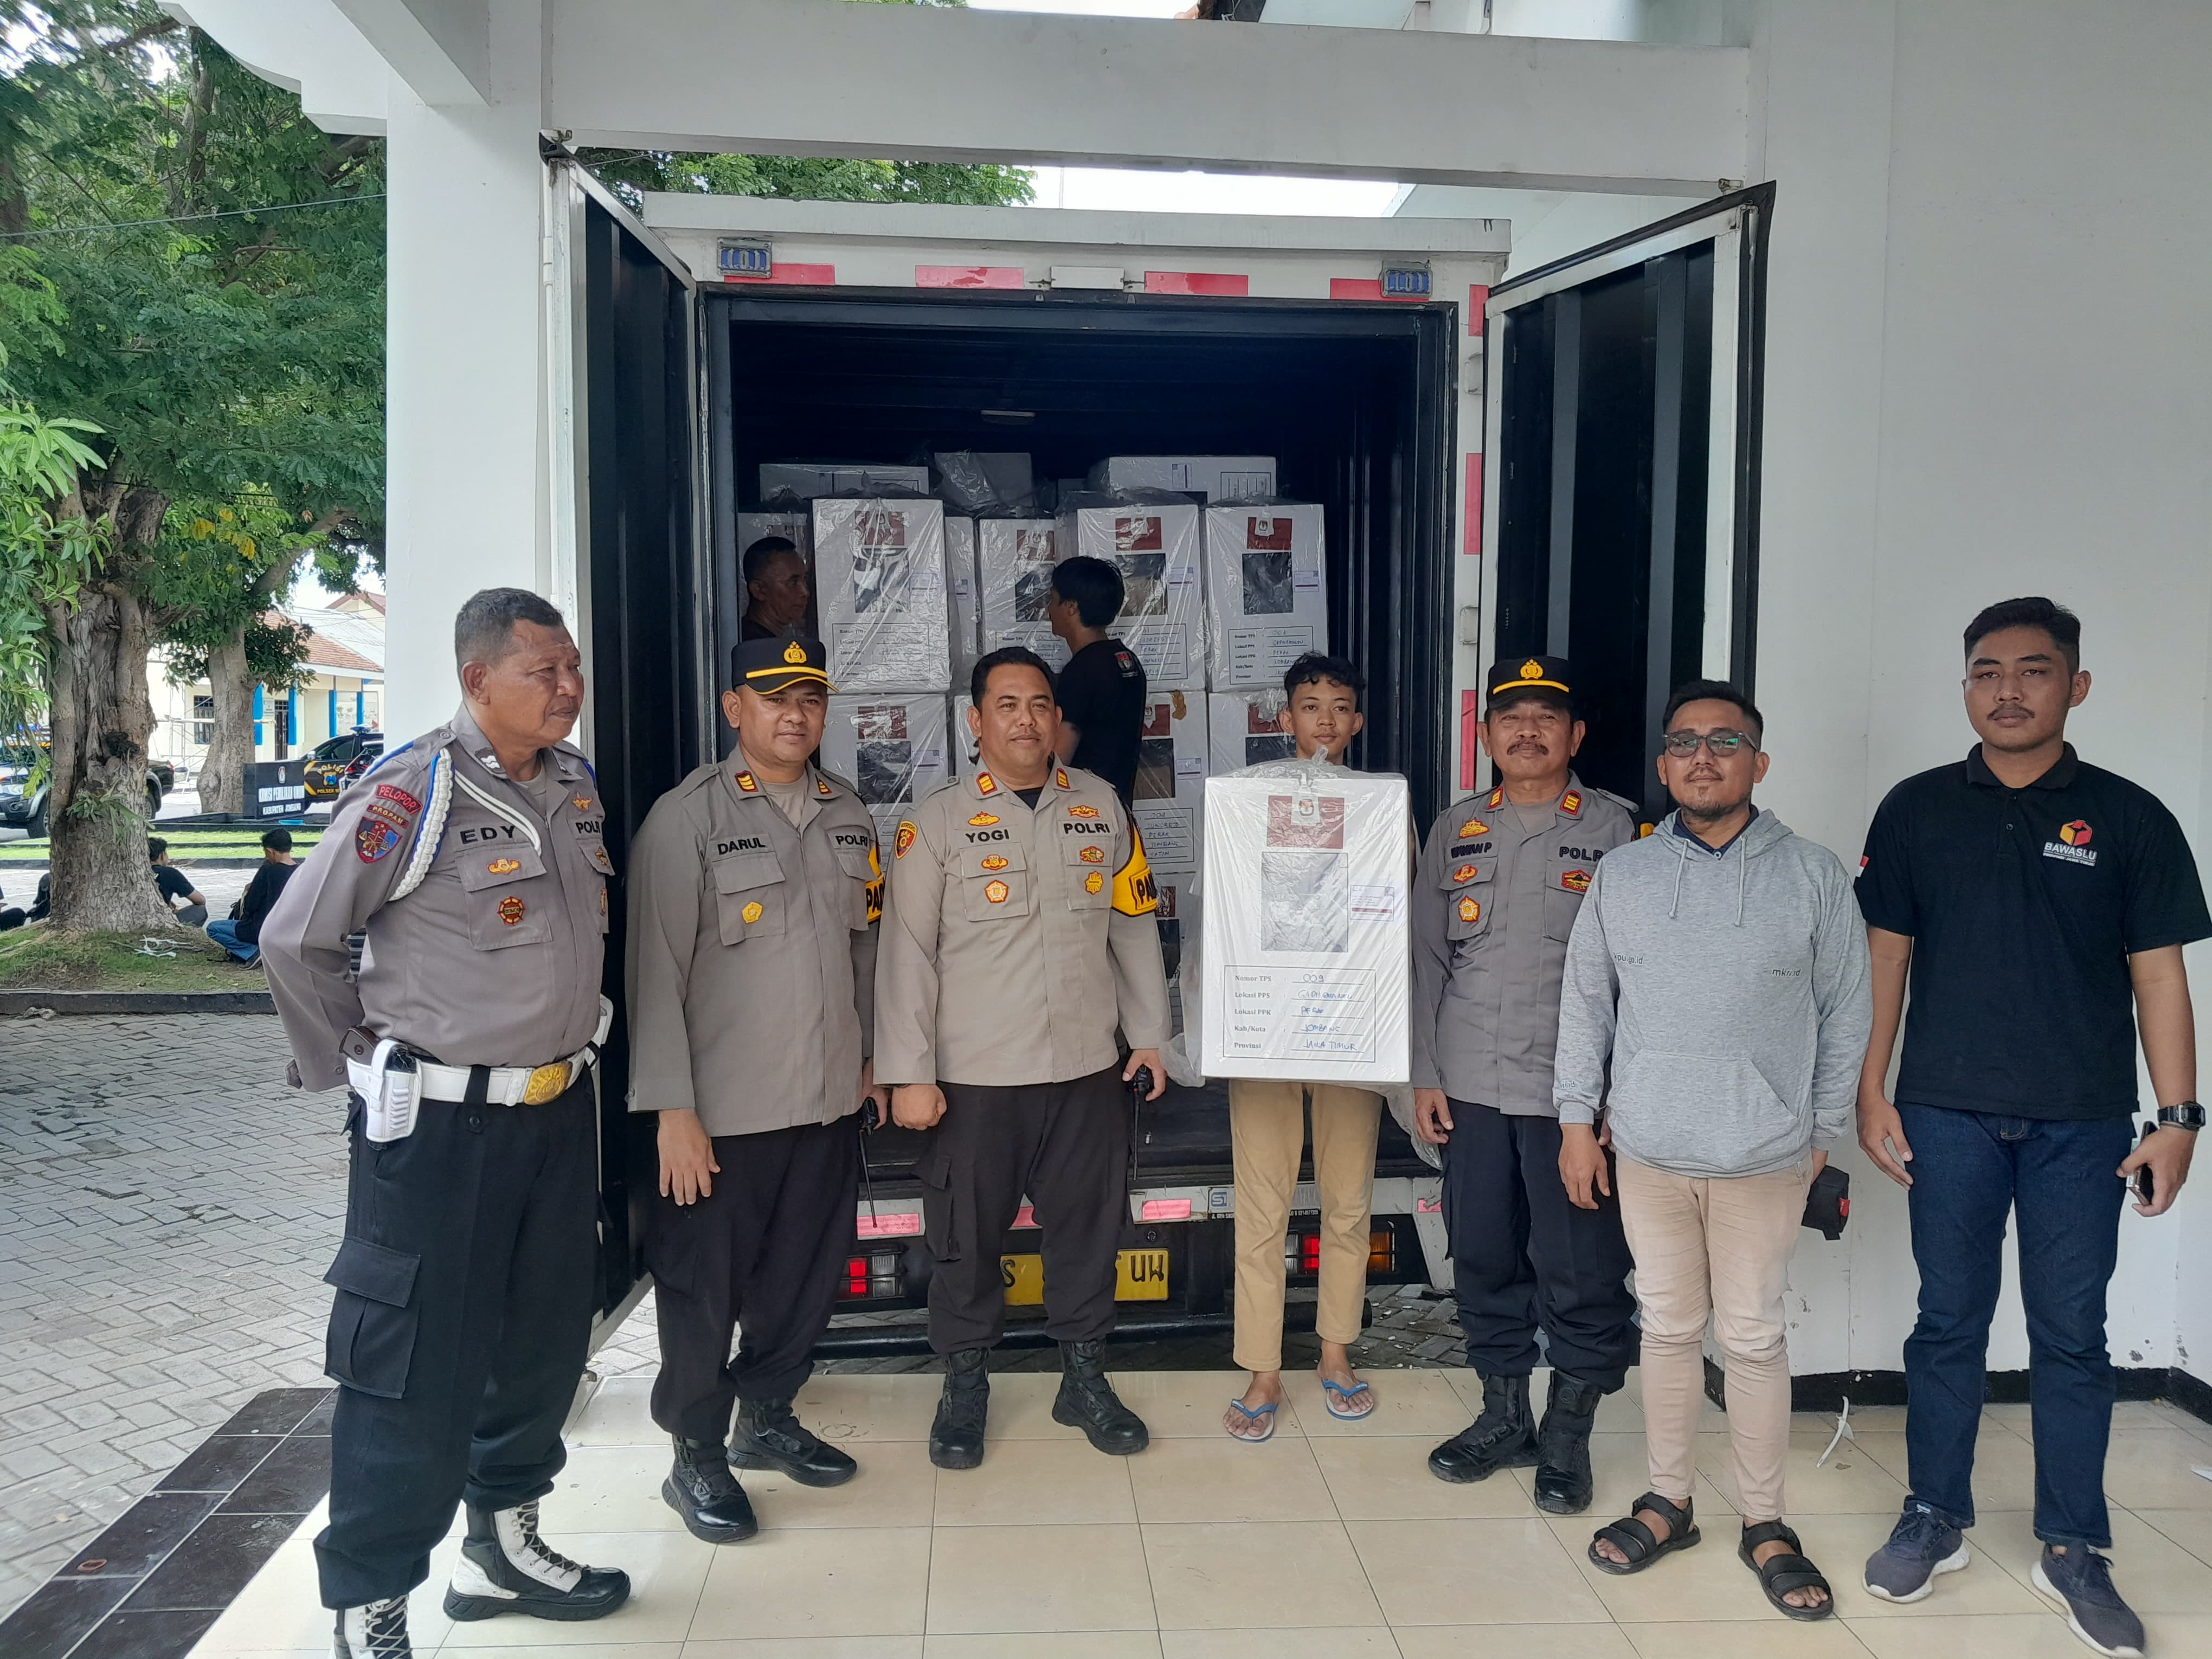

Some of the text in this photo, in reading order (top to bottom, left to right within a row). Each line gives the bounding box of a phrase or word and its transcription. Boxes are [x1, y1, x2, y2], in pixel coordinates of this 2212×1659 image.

[317, 764, 344, 774] POLISI
[378, 786, 417, 810] PELOPOR
[460, 825, 516, 844] EDY
[1063, 822, 1110, 835] POLRI
[835, 834, 868, 847] POLRI
[965, 829, 1010, 844] YOGI
[717, 837, 766, 855] DARUL
[2044, 841, 2098, 860] BAWASLU
[1559, 846, 1604, 861] POLR
[1303, 973, 1324, 982] 009
[1772, 968, 1802, 976] mkri.id
[1329, 1040, 1358, 1051] TIMUR
